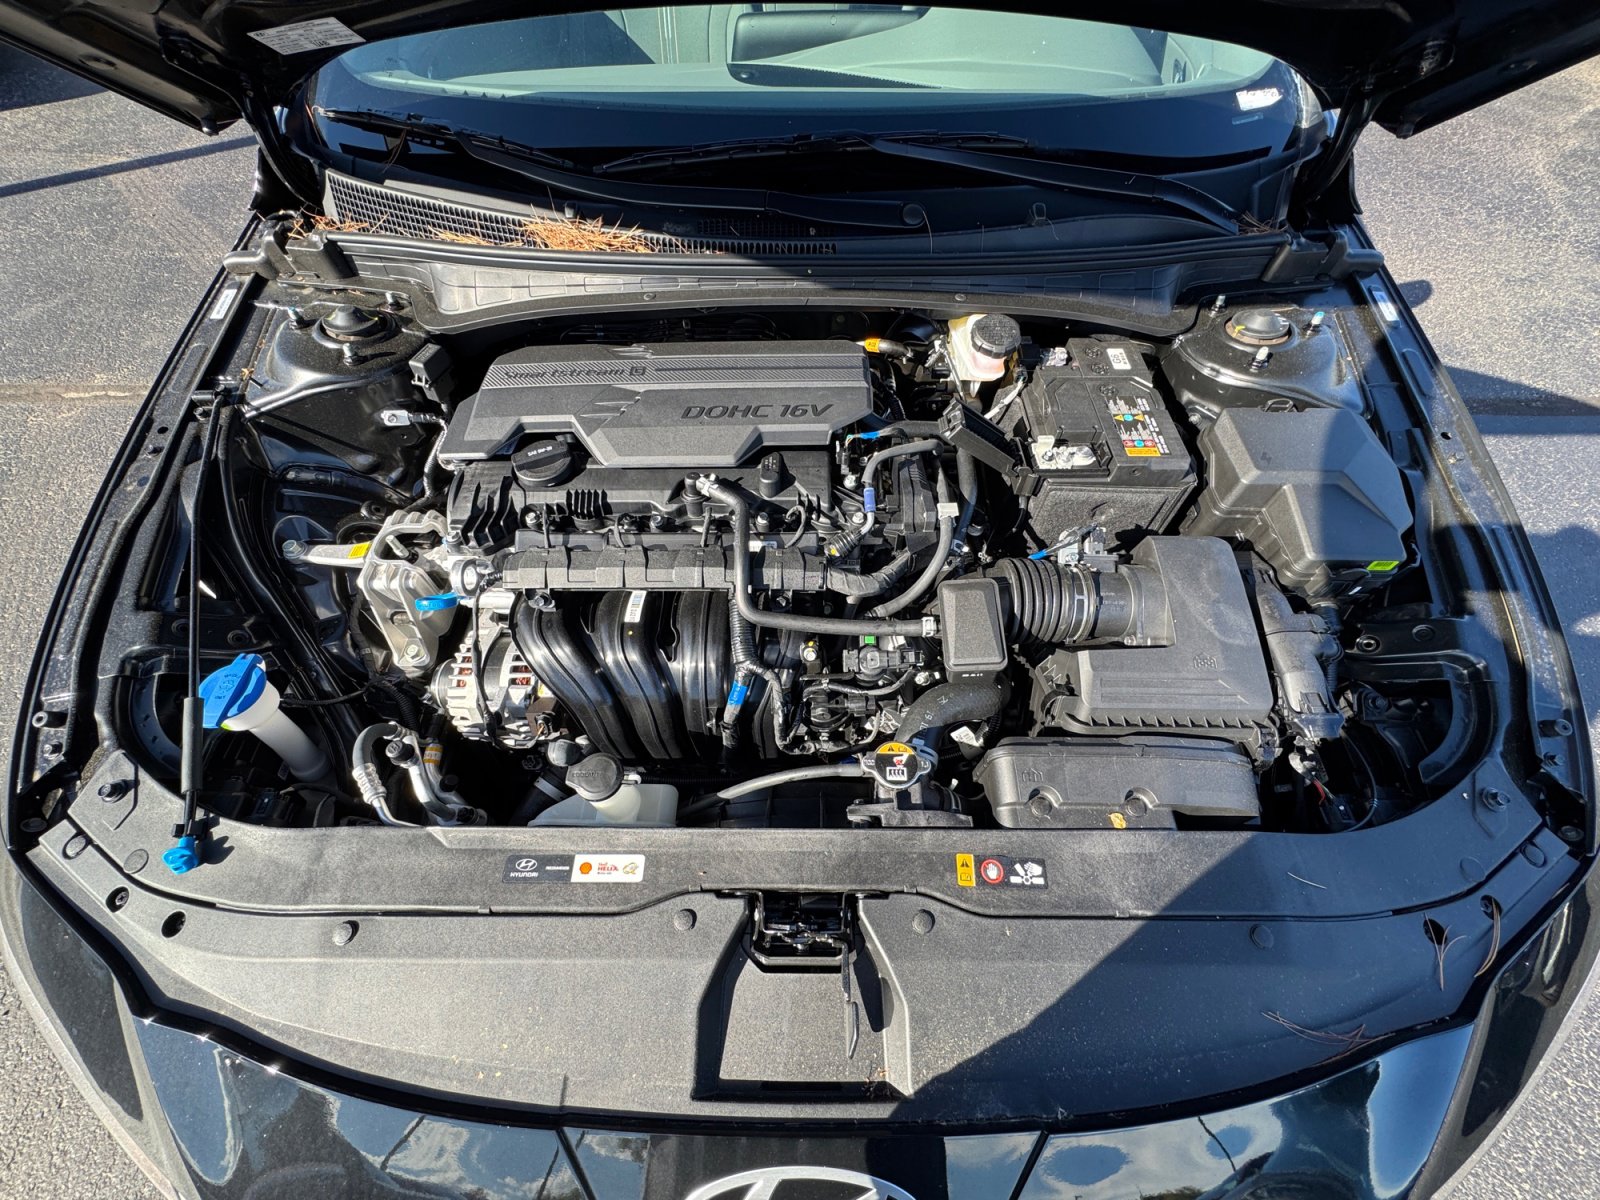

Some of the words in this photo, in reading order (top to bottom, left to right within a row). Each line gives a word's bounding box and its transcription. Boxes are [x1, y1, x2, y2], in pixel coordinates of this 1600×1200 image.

[504, 367, 625, 380] Smartstream
[681, 404, 773, 419] DOHC
[779, 403, 835, 418] 16V
